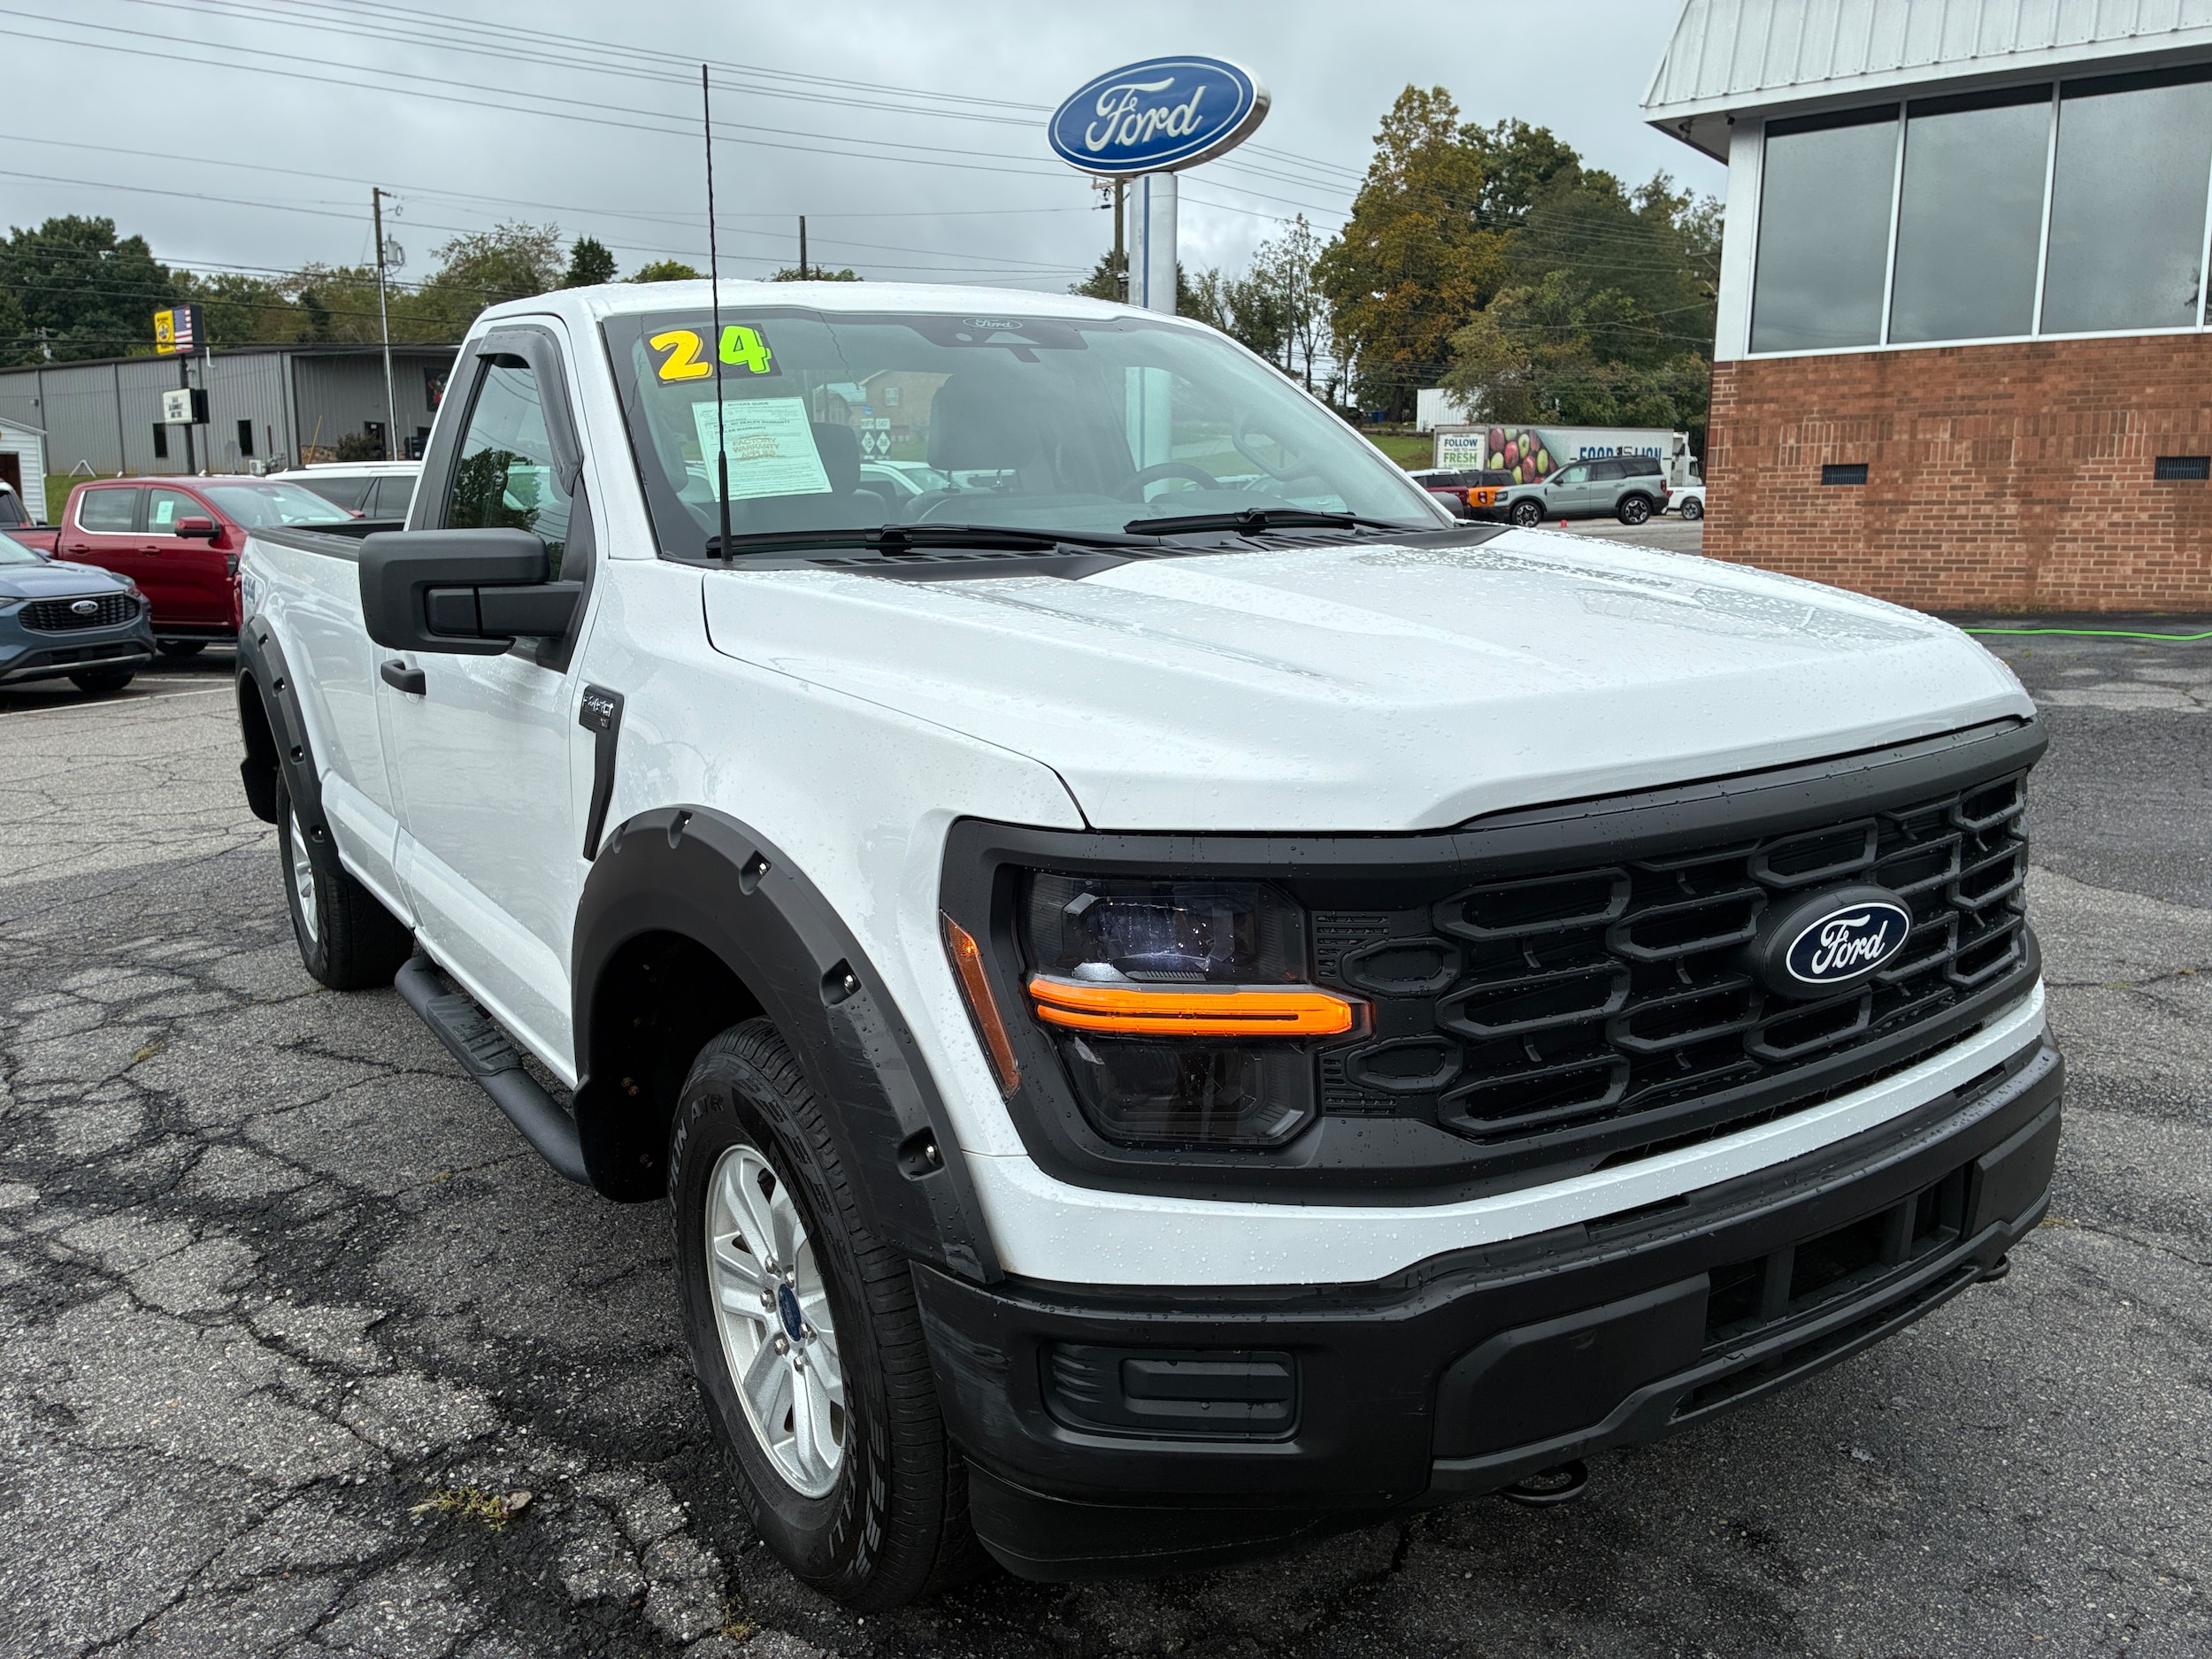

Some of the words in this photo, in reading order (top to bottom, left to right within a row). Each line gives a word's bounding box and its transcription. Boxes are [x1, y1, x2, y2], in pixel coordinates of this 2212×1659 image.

[1085, 76, 1207, 152] Ford
[974, 318, 1012, 328] Ford
[733, 437, 776, 446] FACTORY
[733, 444, 780, 453] WARRANTY
[1444, 453, 1477, 463] FRESH
[1811, 913, 1889, 974] Ford
[690, 1093, 725, 1125] ATR
[828, 1361, 858, 1560] PIRELLI
